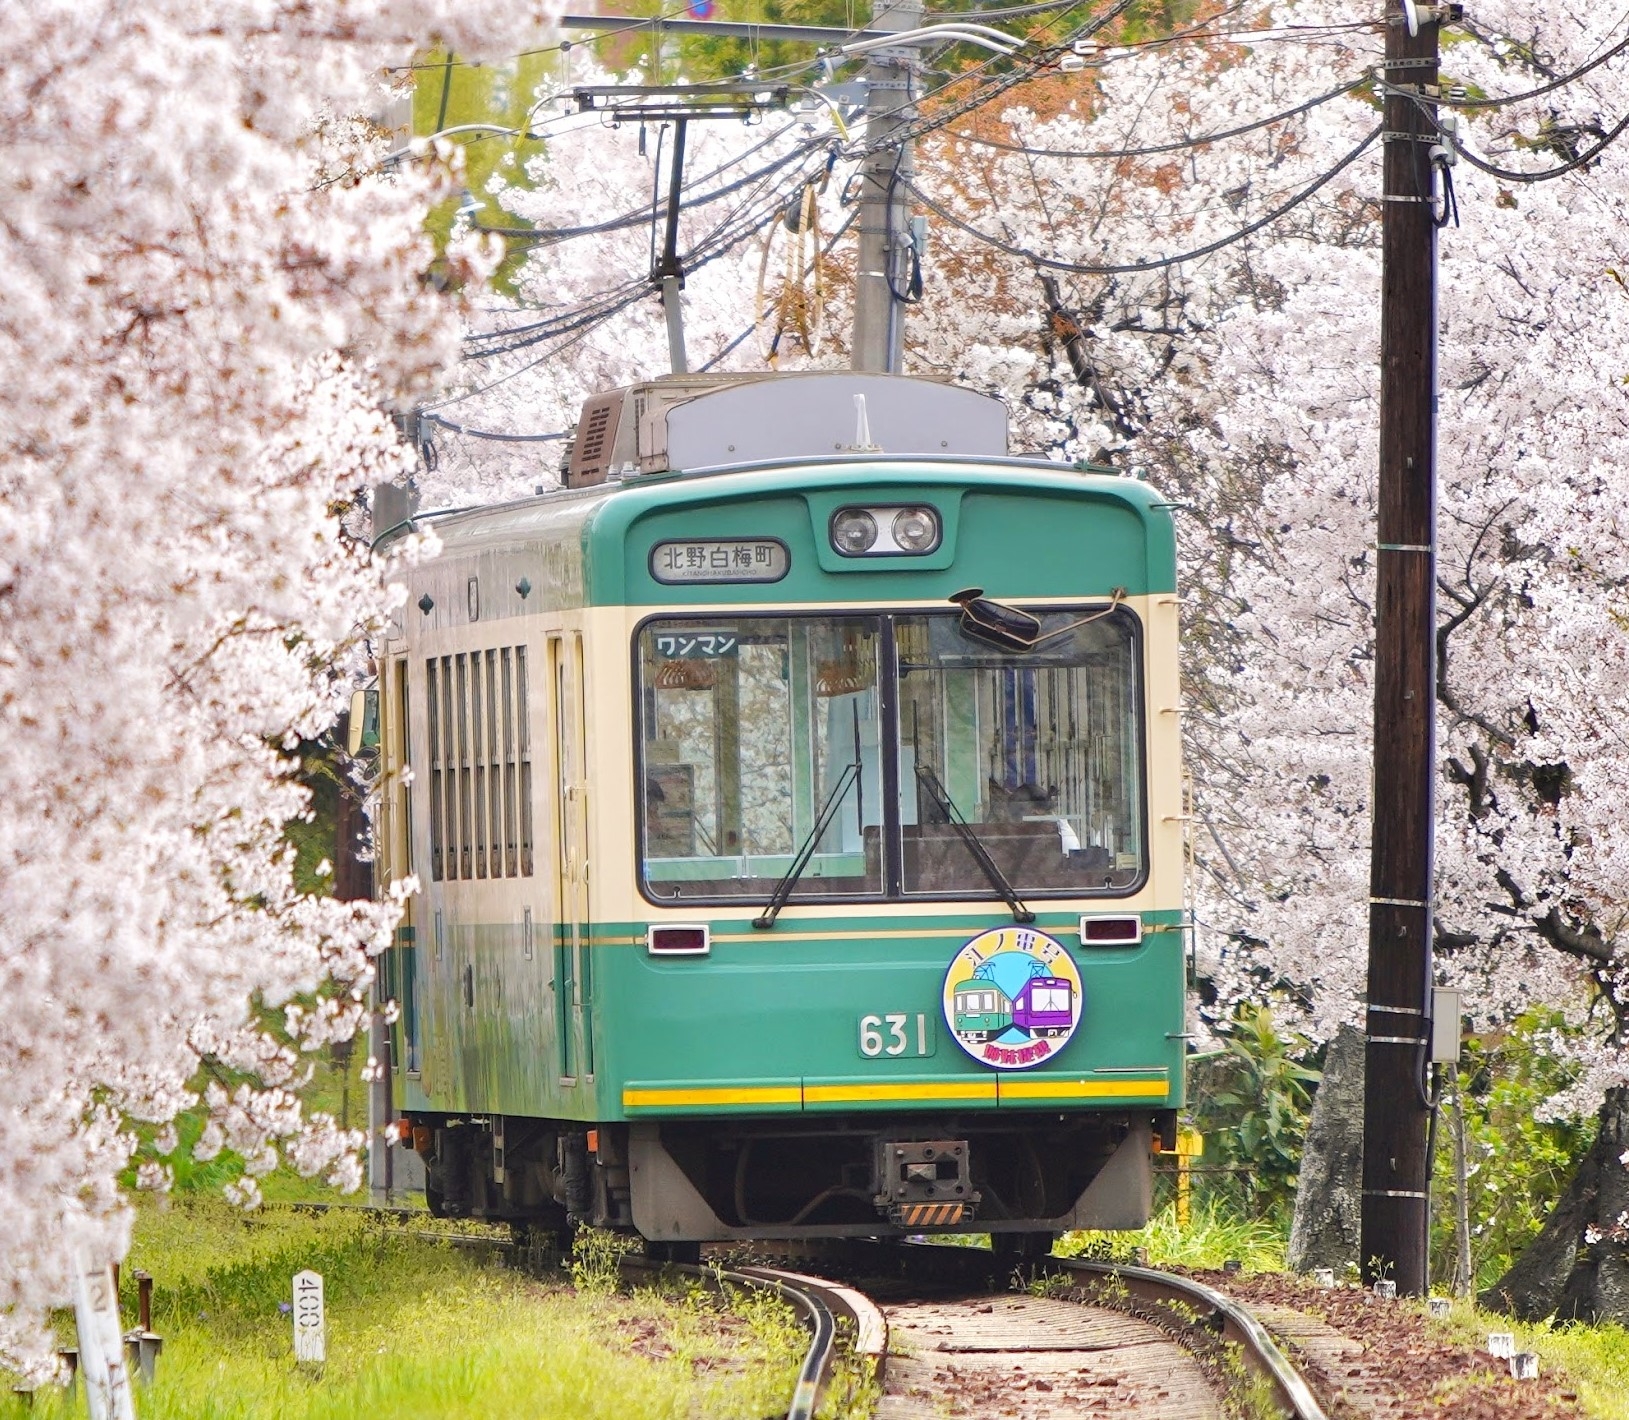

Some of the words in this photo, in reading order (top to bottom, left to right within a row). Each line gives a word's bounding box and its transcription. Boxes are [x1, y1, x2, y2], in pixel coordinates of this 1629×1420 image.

[663, 545, 775, 570] 北野白梅町
[657, 636, 736, 656] ワンマン
[860, 1013, 926, 1056] 631
[298, 1278, 320, 1327] 400
